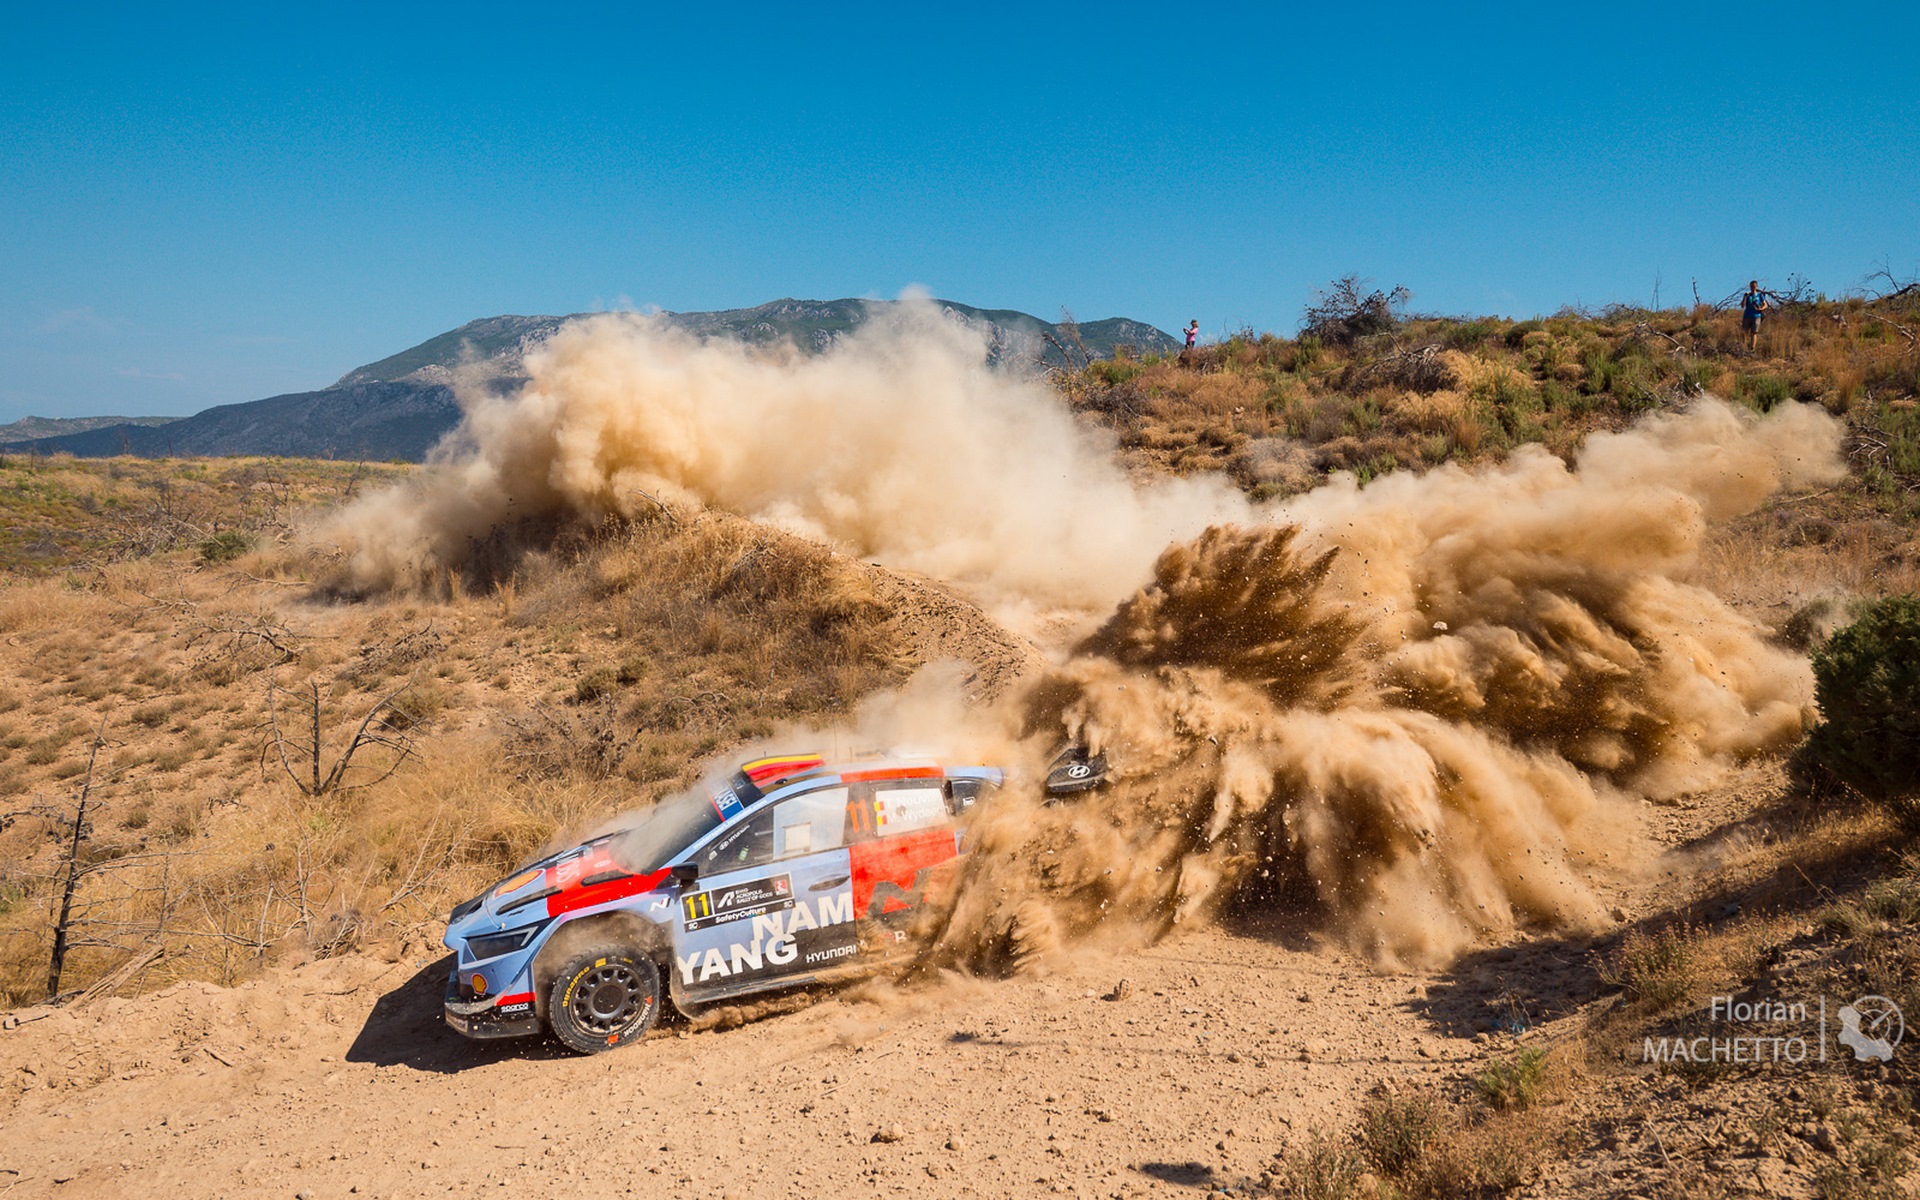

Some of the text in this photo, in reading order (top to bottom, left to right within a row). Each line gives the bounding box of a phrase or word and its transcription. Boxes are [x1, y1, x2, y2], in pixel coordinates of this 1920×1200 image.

[846, 798, 871, 833] 11
[736, 889, 763, 898] ACROPOLIS
[736, 896, 751, 904] RALLY
[759, 892, 773, 900] GODS
[686, 893, 709, 919] 11
[715, 907, 767, 924] SafetyCulture
[752, 891, 855, 940] NAM
[676, 933, 798, 985] YANG
[805, 944, 857, 963] HYUNDAI
[501, 1002, 529, 1013] sparco
